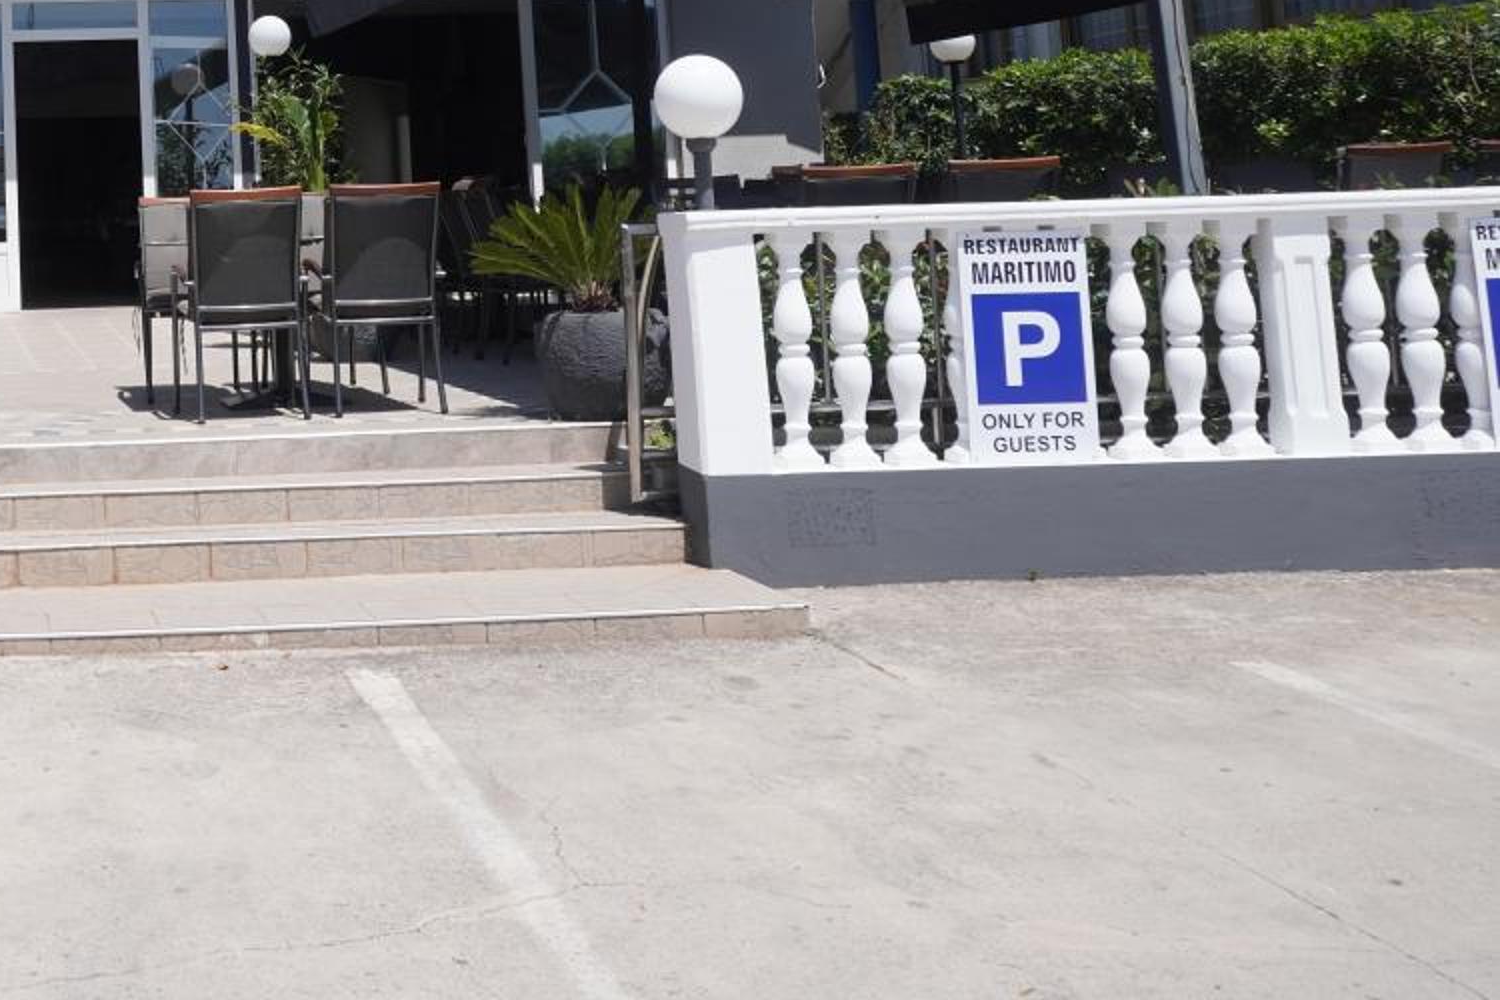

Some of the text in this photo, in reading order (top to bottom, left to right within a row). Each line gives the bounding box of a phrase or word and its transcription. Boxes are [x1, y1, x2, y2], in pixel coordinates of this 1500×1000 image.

[963, 236, 1080, 255] RESTAURANT
[971, 260, 1076, 285] MARITIMO
[1001, 310, 1061, 387] P
[981, 411, 1085, 430] ONLY FOR
[993, 435, 1077, 453] GUESTS
